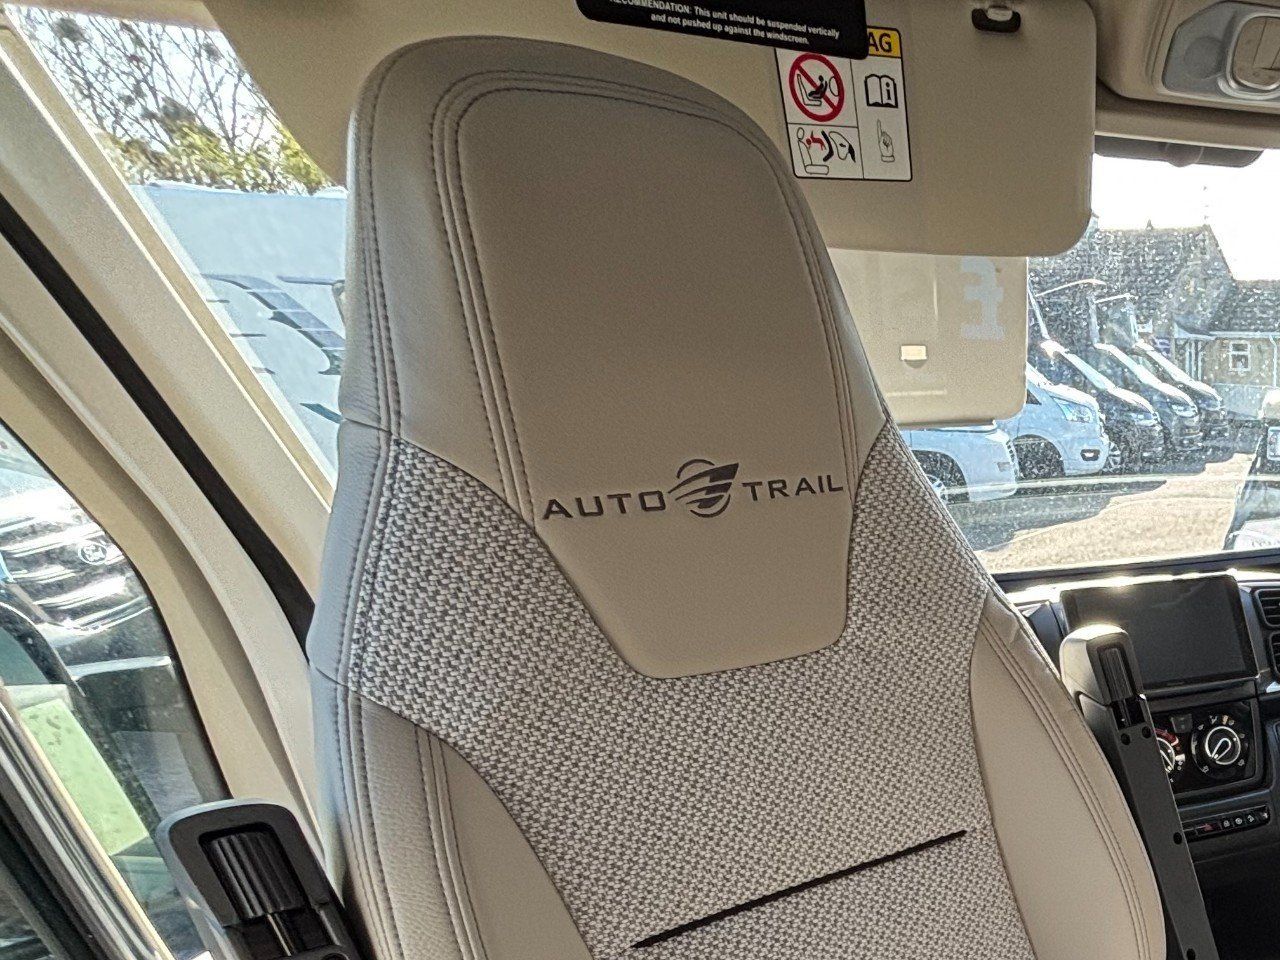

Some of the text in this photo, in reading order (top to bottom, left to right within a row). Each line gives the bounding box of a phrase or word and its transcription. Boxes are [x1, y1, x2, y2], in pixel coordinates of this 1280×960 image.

[651, 13, 809, 45] and not pushed up against the windscreen.
[694, 6, 710, 18] This
[712, 11, 727, 20] unit
[729, 13, 754, 24] should
[756, 16, 766, 26] be
[767, 20, 807, 32] suspended
[808, 26, 840, 40] vertically
[543, 474, 844, 521] AUTO TRAIL
